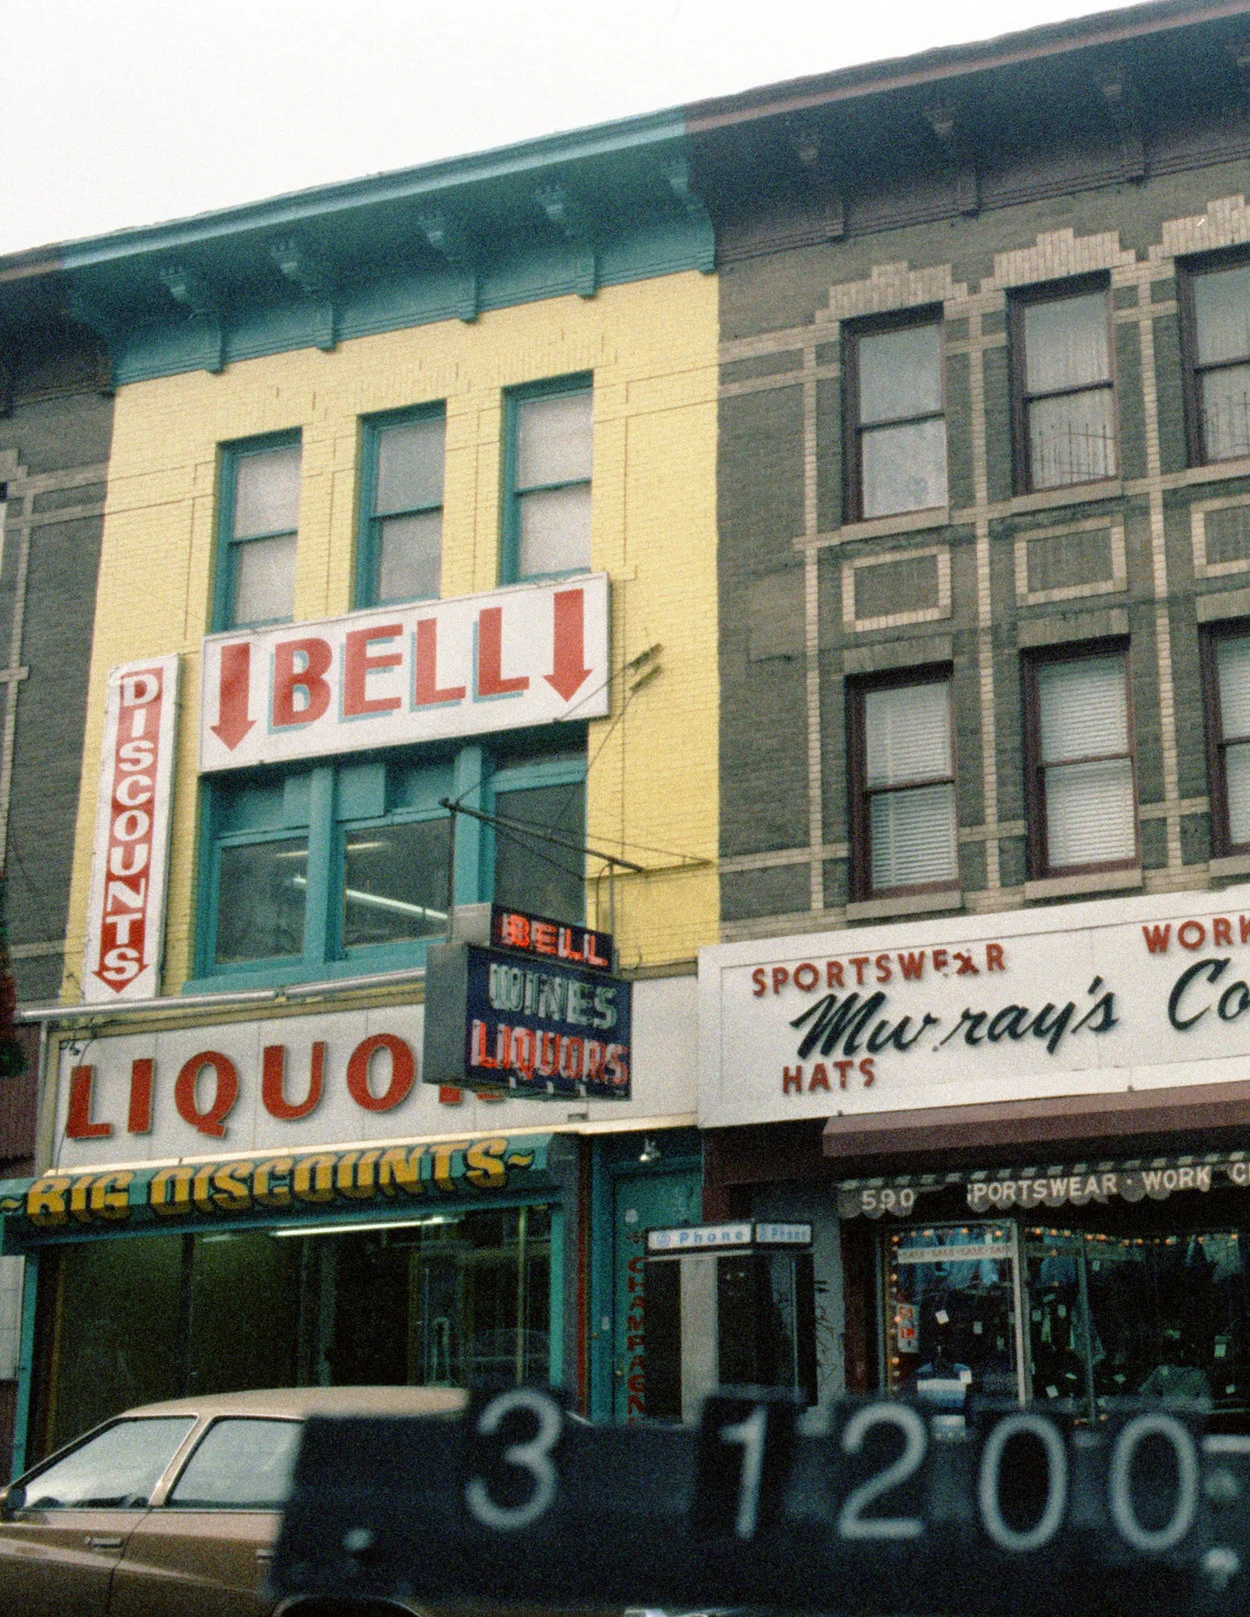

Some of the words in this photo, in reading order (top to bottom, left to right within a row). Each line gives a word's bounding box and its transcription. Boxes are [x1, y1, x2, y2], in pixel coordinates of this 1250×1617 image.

[268, 607, 530, 735] BELL
[102, 674, 160, 982] DISCOUNTS
[501, 913, 608, 967] BELL
[751, 943, 1007, 998] SPORTSWEAR
[488, 963, 617, 1029] WINES
[470, 1019, 629, 1086] LIQUORS
[782, 1057, 875, 1094] HATS
[66, 1033, 503, 1139] LIQUO
[27, 1172, 133, 1226] BIG
[150, 1138, 509, 1217] DISCOUNTS
[861, 1188, 915, 1211] 590
[1141, 1165, 1211, 1191] WORK
[678, 1230, 745, 1244] Phone
[771, 1227, 808, 1241] Phone
[627, 1257, 646, 1425] CHAMPAGN
[464, 1389, 563, 1530] 3
[720, 1401, 1203, 1553] 1200
